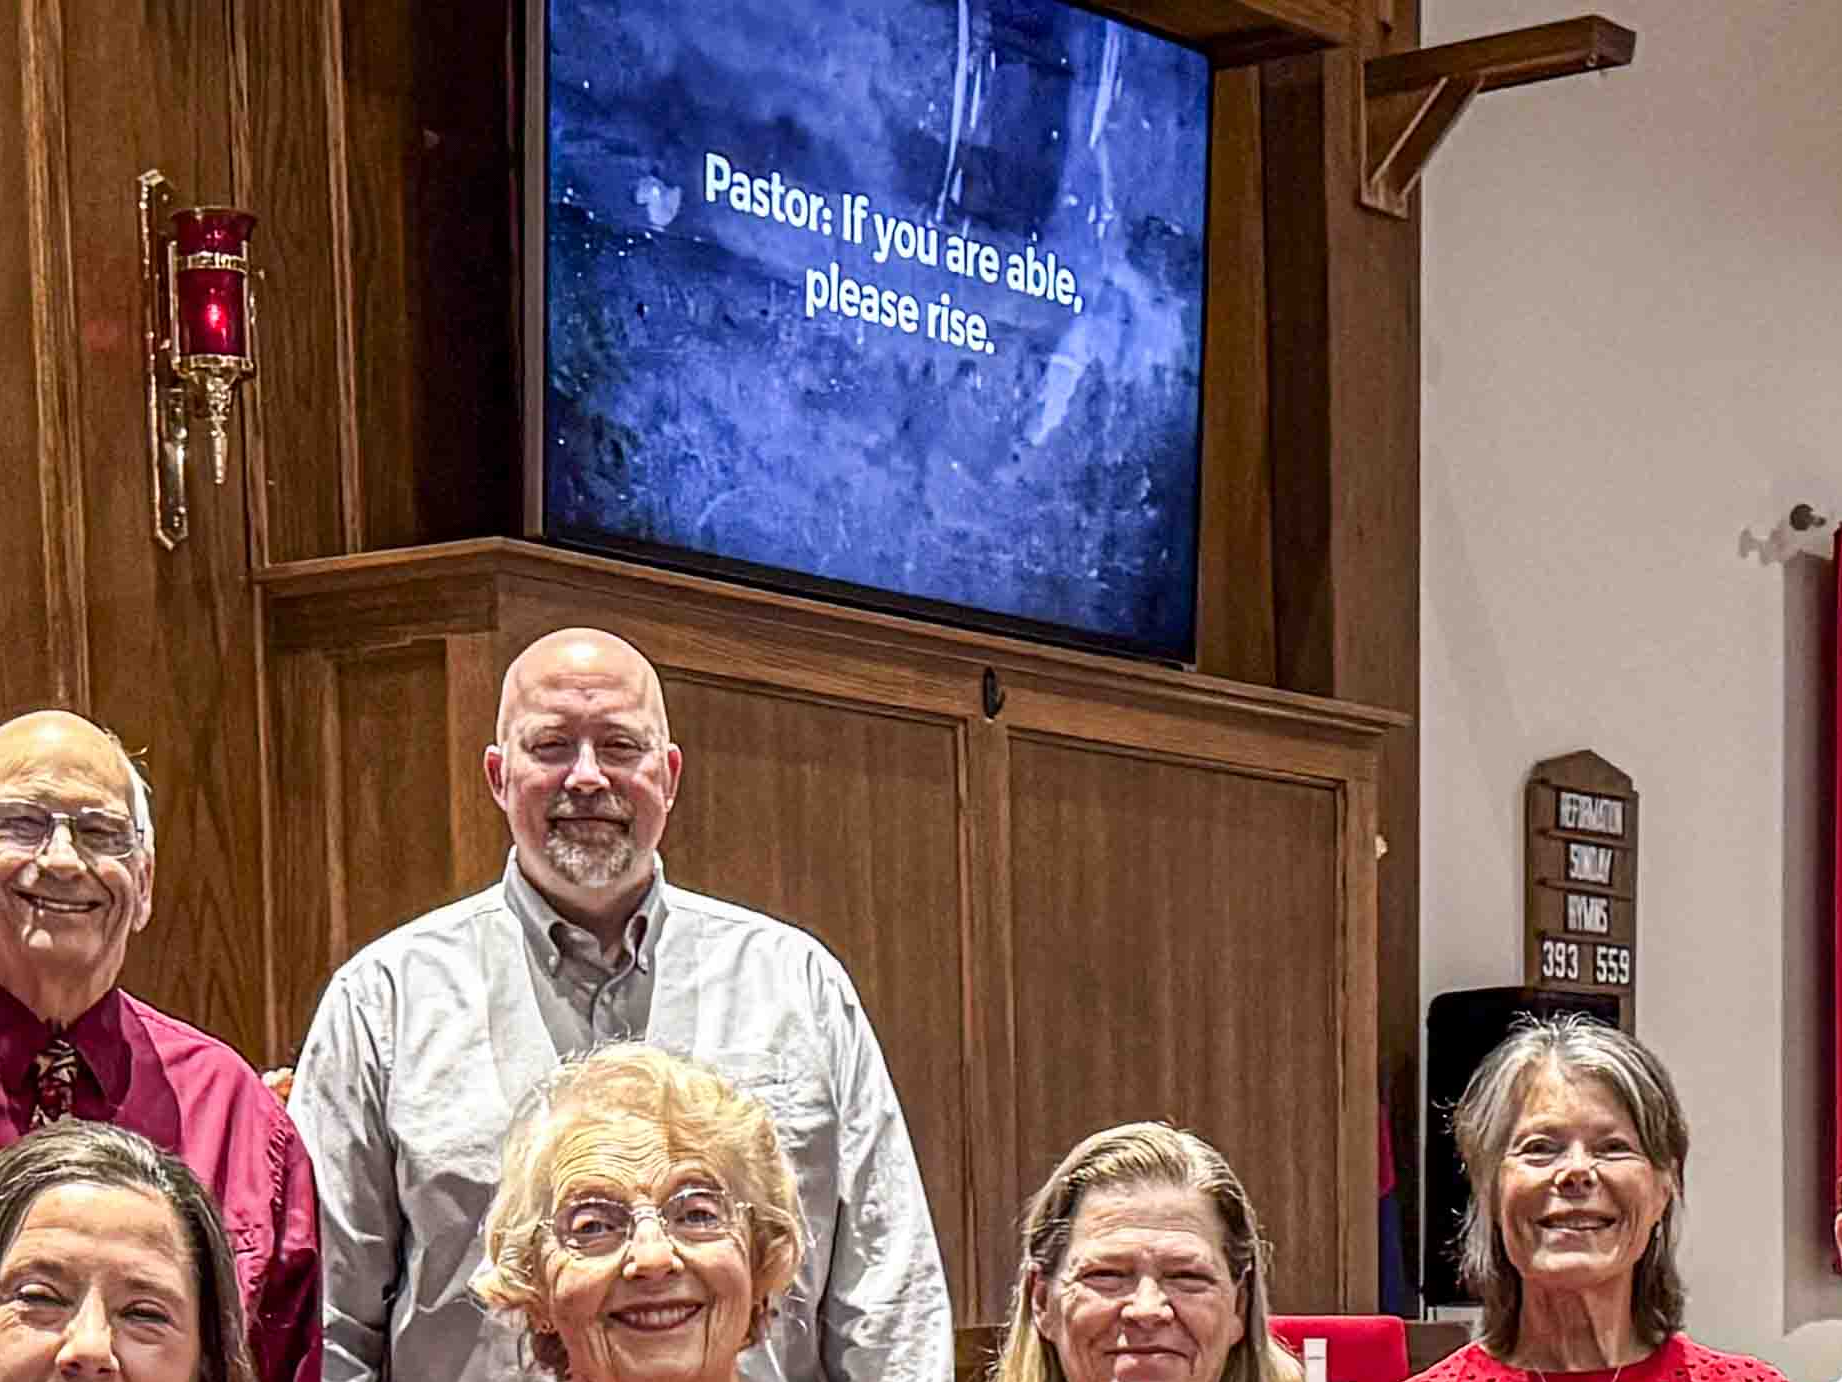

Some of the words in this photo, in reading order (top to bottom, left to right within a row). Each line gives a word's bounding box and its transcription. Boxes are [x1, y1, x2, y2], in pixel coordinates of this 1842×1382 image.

[704, 152, 832, 238] Pastor:
[841, 192, 868, 244] If
[873, 211, 939, 264] you
[945, 234, 999, 282] are
[805, 262, 919, 333] please
[927, 293, 996, 355] rise.
[1542, 941, 1579, 980] 393
[1595, 945, 1630, 985] 559
